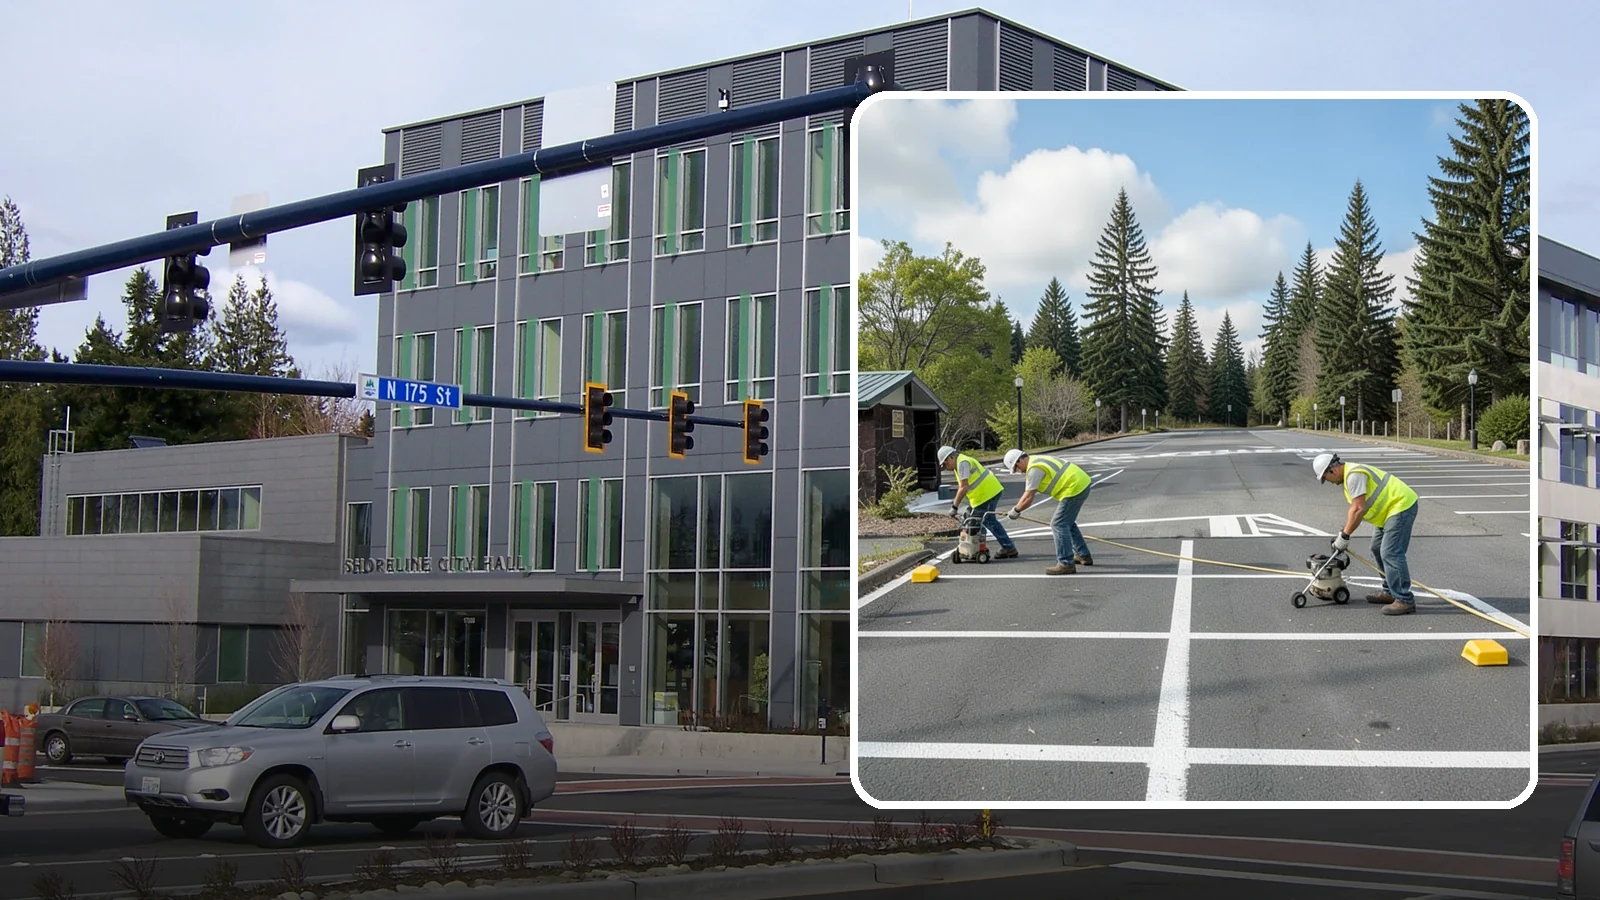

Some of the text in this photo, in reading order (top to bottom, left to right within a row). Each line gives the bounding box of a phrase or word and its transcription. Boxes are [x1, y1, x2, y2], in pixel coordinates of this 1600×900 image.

[387, 380, 451, 406] N 175 St
[344, 556, 526, 574] SHORELINE CITY HALL
